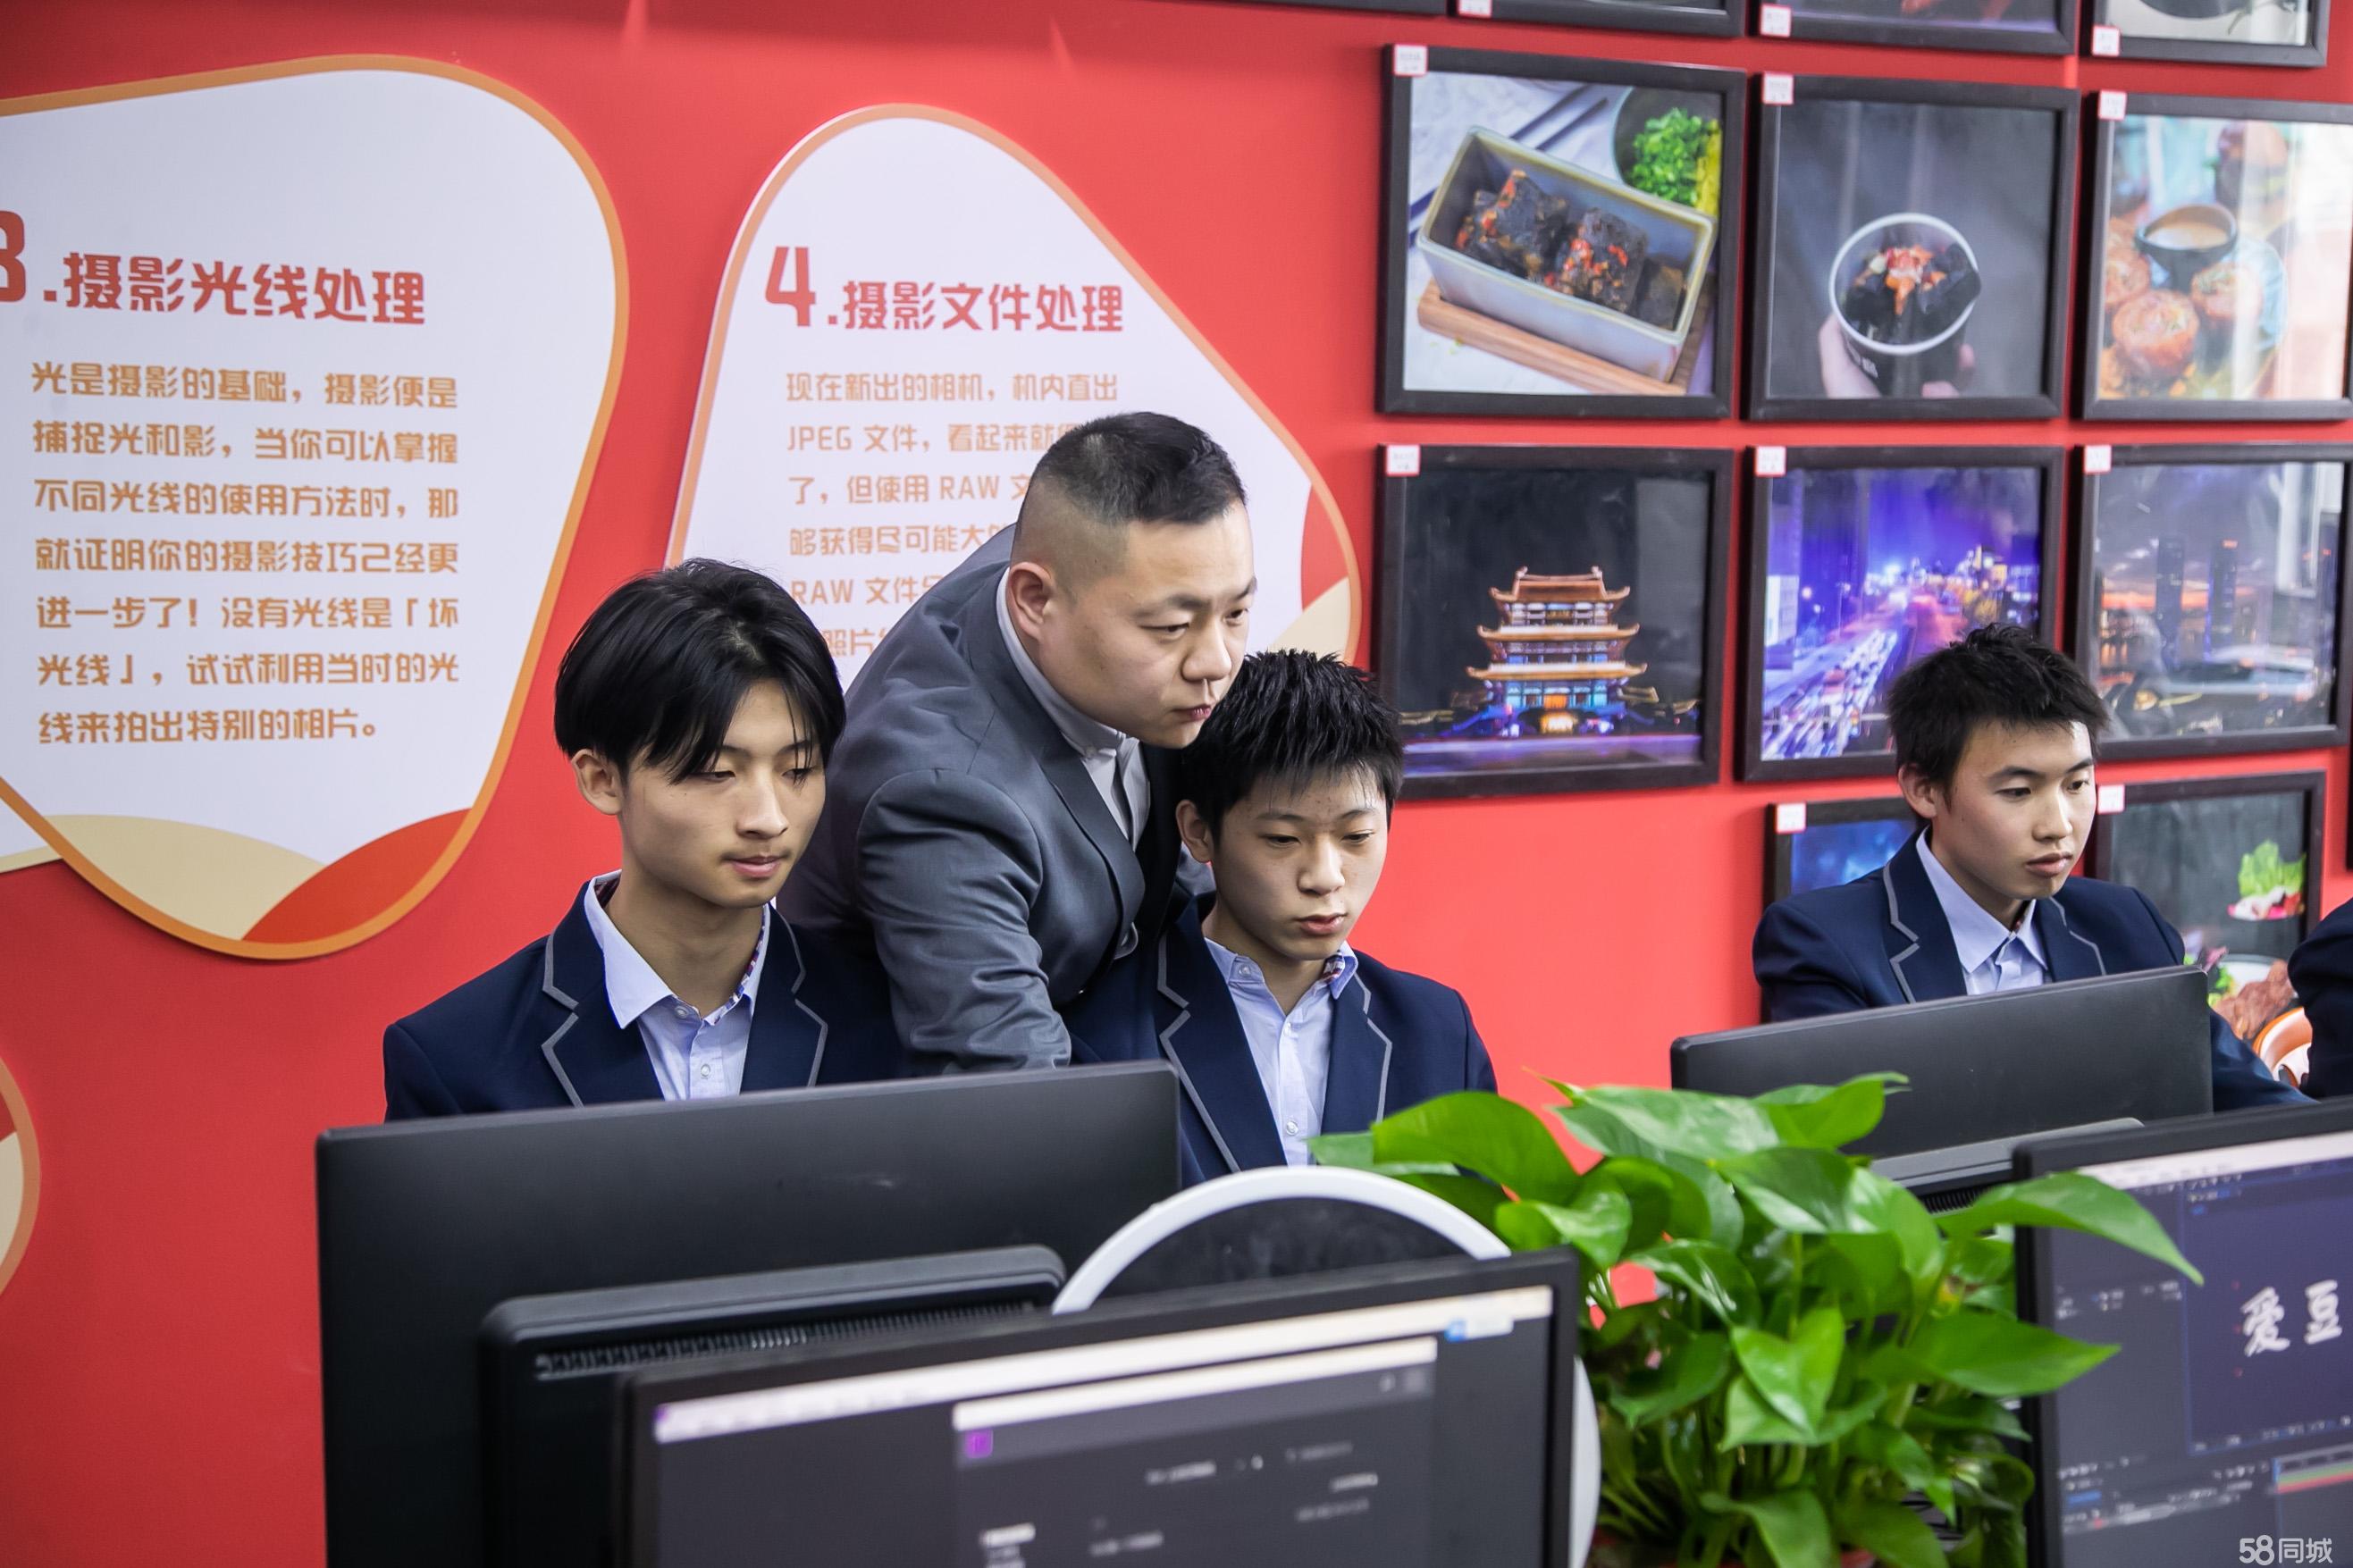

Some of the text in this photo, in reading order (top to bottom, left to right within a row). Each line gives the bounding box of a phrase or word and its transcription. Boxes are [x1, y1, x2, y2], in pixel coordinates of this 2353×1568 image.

[764, 247, 1123, 332] 4.摄影文件处理
[787, 423, 1078, 454] JPEG 文件，看起来就
[939, 474, 1000, 500] RAW
[789, 524, 1003, 556] 够获得尽可能大
[790, 578, 853, 606] RAW
[821, 628, 886, 658] 照片
[38, 708, 375, 743] 线来拍出特别的相片。
